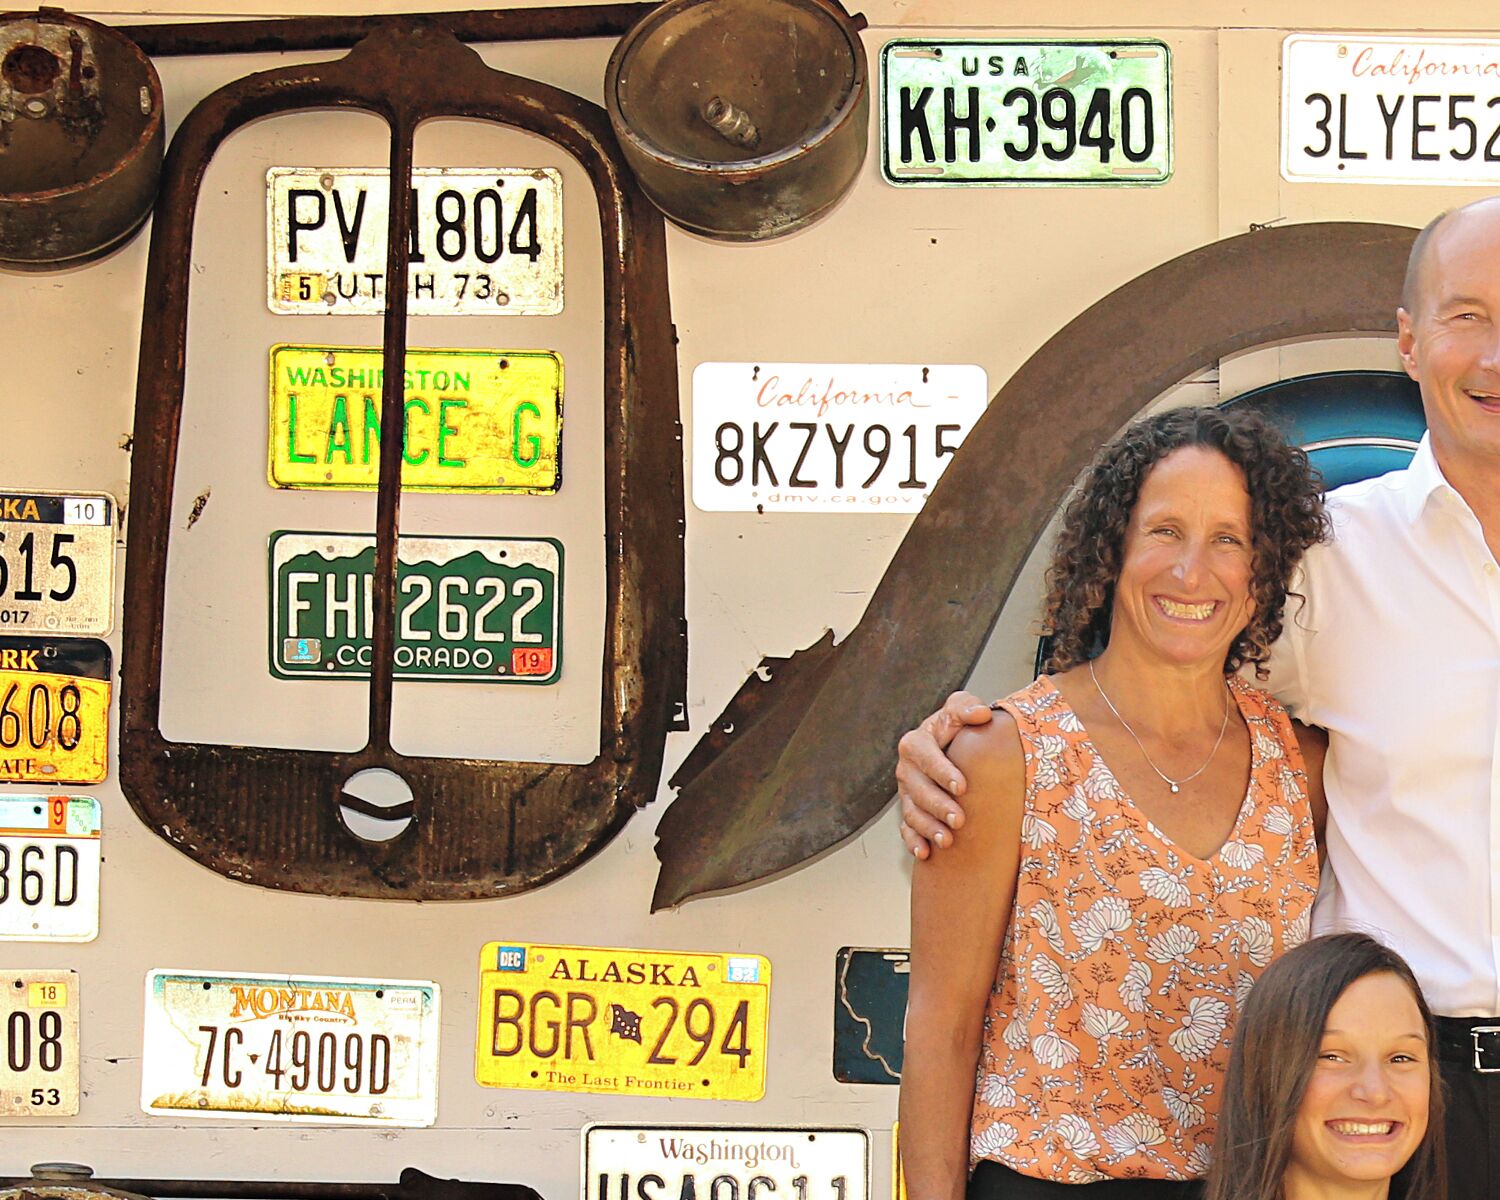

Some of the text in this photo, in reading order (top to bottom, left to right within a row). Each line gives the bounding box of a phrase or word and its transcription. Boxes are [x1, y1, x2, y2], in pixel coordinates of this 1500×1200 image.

[962, 55, 1030, 77] USA
[288, 188, 367, 263] PV
[299, 276, 311, 300] 5
[336, 274, 492, 300] UTH 73
[756, 375, 932, 418] California
[287, 394, 542, 468] LANCE G
[714, 421, 962, 489] 8KZY915
[0, 498, 41, 521] KA
[767, 491, 913, 505] dmv.ca.gov
[74, 503, 95, 520] 10
[297, 640, 309, 655] 5
[336, 645, 494, 669] COORADO
[0, 649, 40, 671] RK
[519, 653, 540, 668] 19
[0, 681, 82, 751] 608
[53, 799, 65, 826] 9
[500, 952, 521, 968] DEC
[549, 958, 702, 988] ALASKA
[39, 985, 57, 1000] 18
[229, 986, 357, 1021] MONTANA
[390, 996, 417, 1005] PERM
[313, 1015, 349, 1024] Country
[7, 1010, 63, 1072] 08
[545, 1071, 696, 1092] The Last Frontier
[30, 1088, 61, 1106] 53
[659, 1137, 801, 1170] Washington
